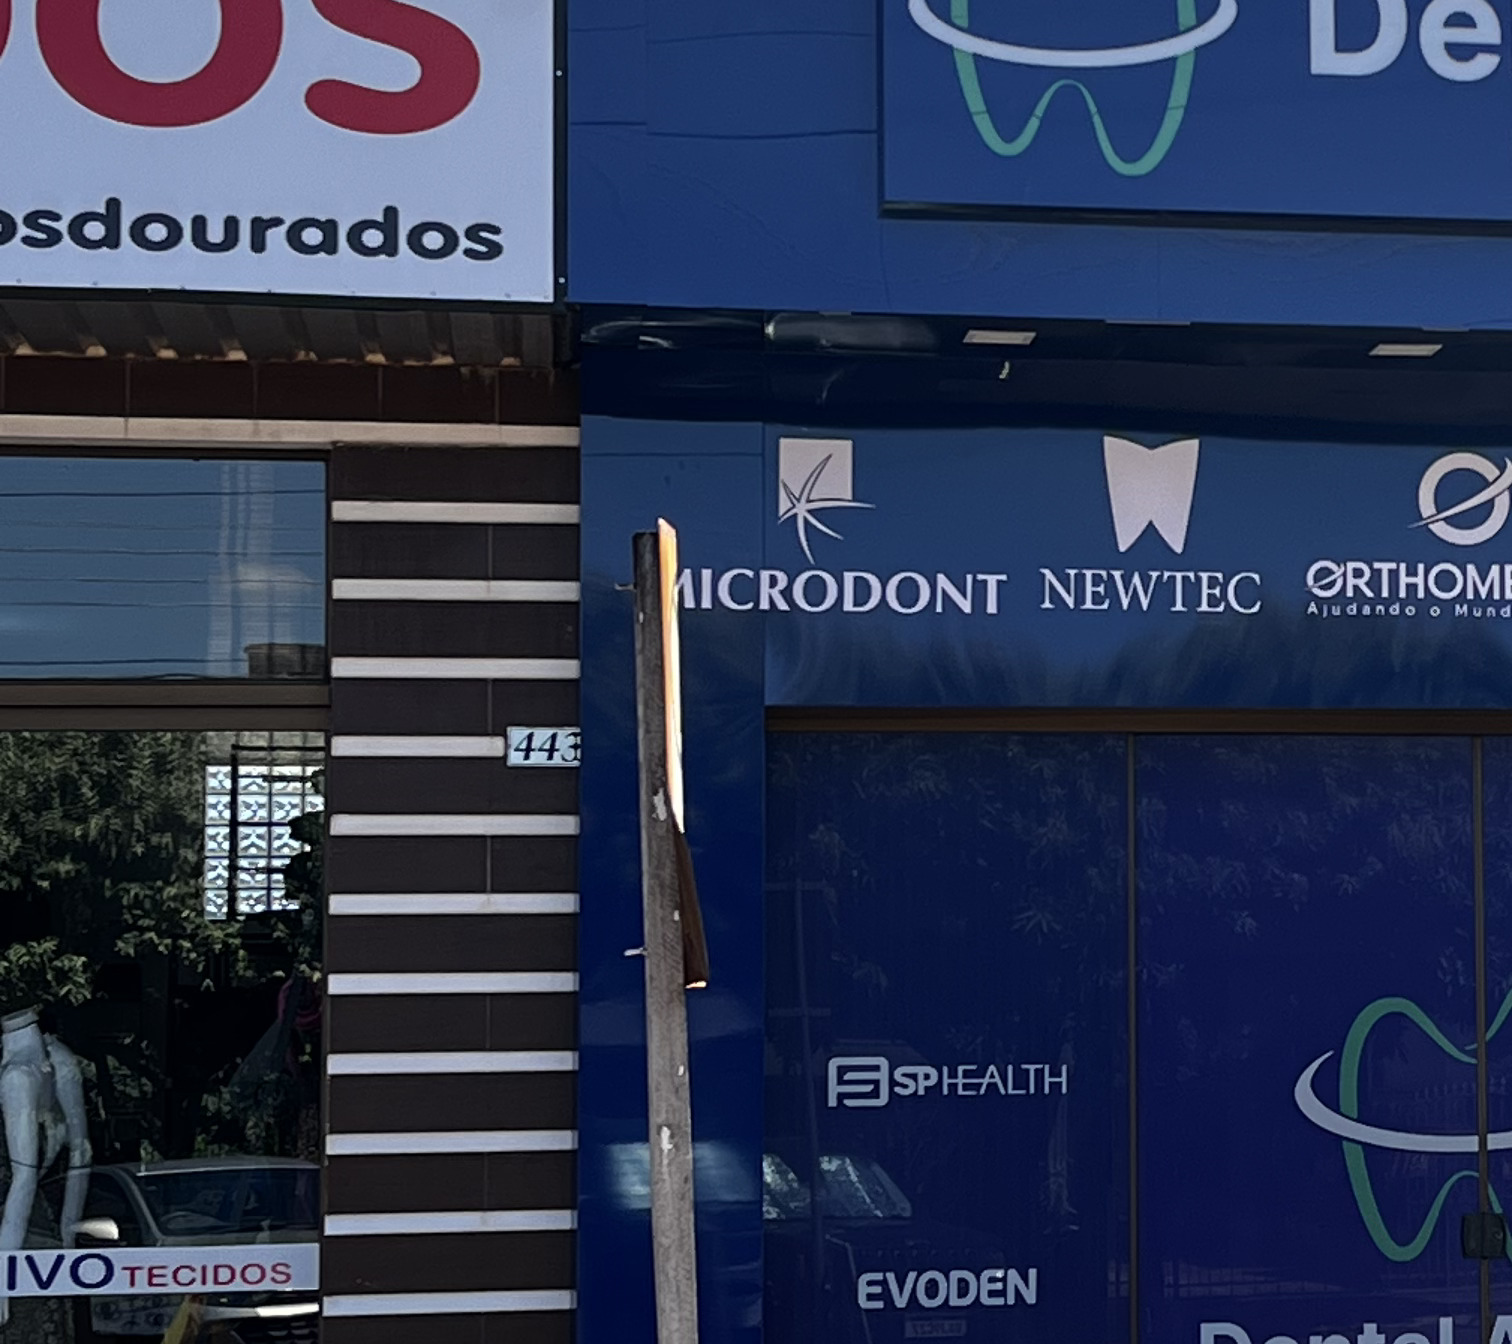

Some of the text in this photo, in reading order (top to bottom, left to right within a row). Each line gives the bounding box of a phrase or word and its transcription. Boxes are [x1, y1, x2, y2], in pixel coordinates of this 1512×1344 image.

[1039, 568, 1262, 614] NEWTEC
[1306, 601, 1416, 618] Ajudando
[1429, 605, 1441, 617] o
[121, 1262, 293, 1289] TECIDOS
[857, 1267, 1038, 1309] EVODEN
